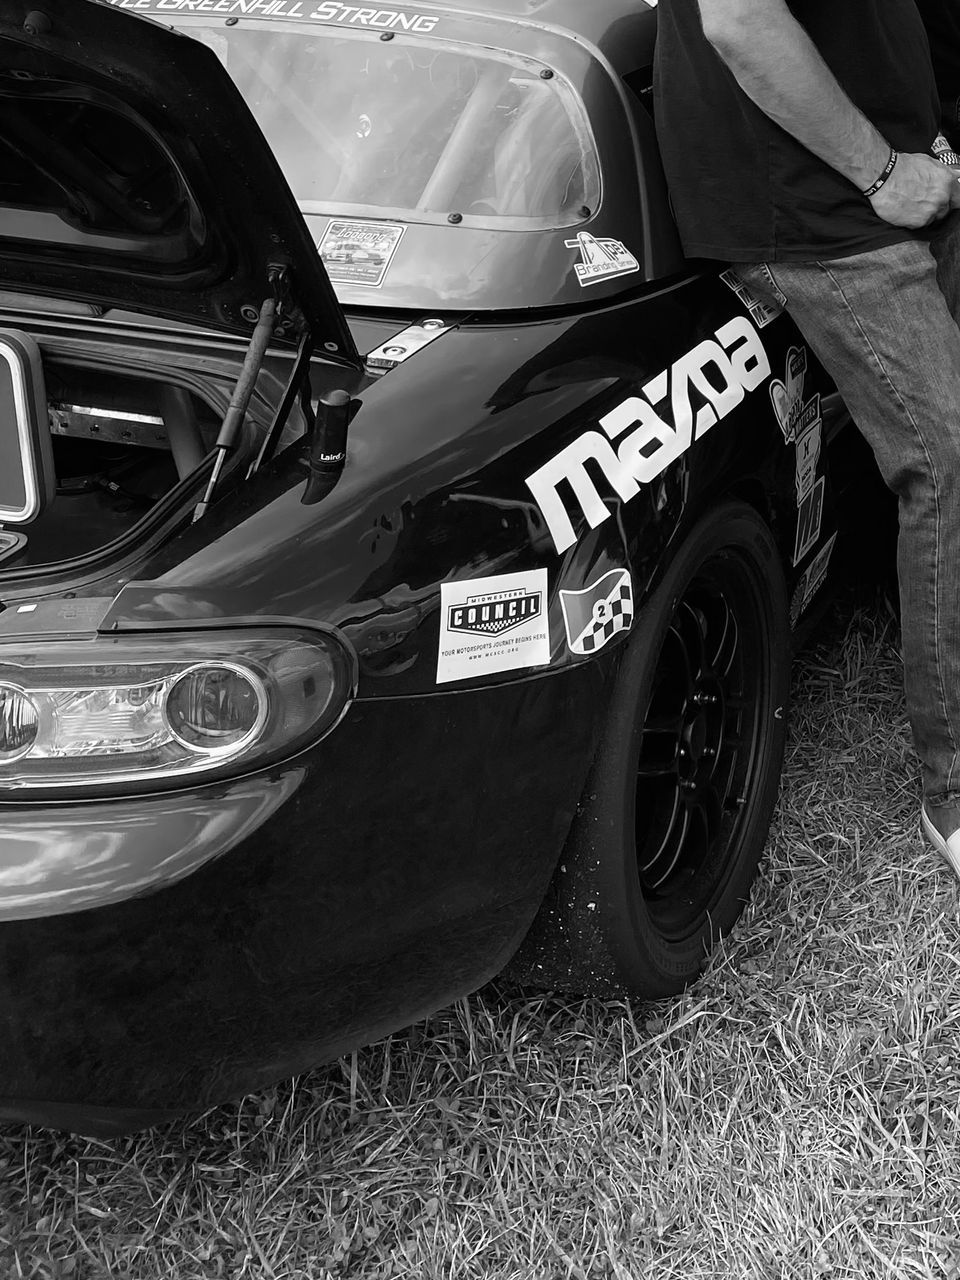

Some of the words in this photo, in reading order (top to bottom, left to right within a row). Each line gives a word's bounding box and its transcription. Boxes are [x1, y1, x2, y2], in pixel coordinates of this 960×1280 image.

[309, 1, 440, 34] STRONG
[320, 452, 342, 460] Laird
[471, 590, 524, 604] MIDWESTERN
[453, 598, 537, 626] COUNCIL
[597, 604, 606, 617] 2
[442, 648, 456, 657] YOUR
